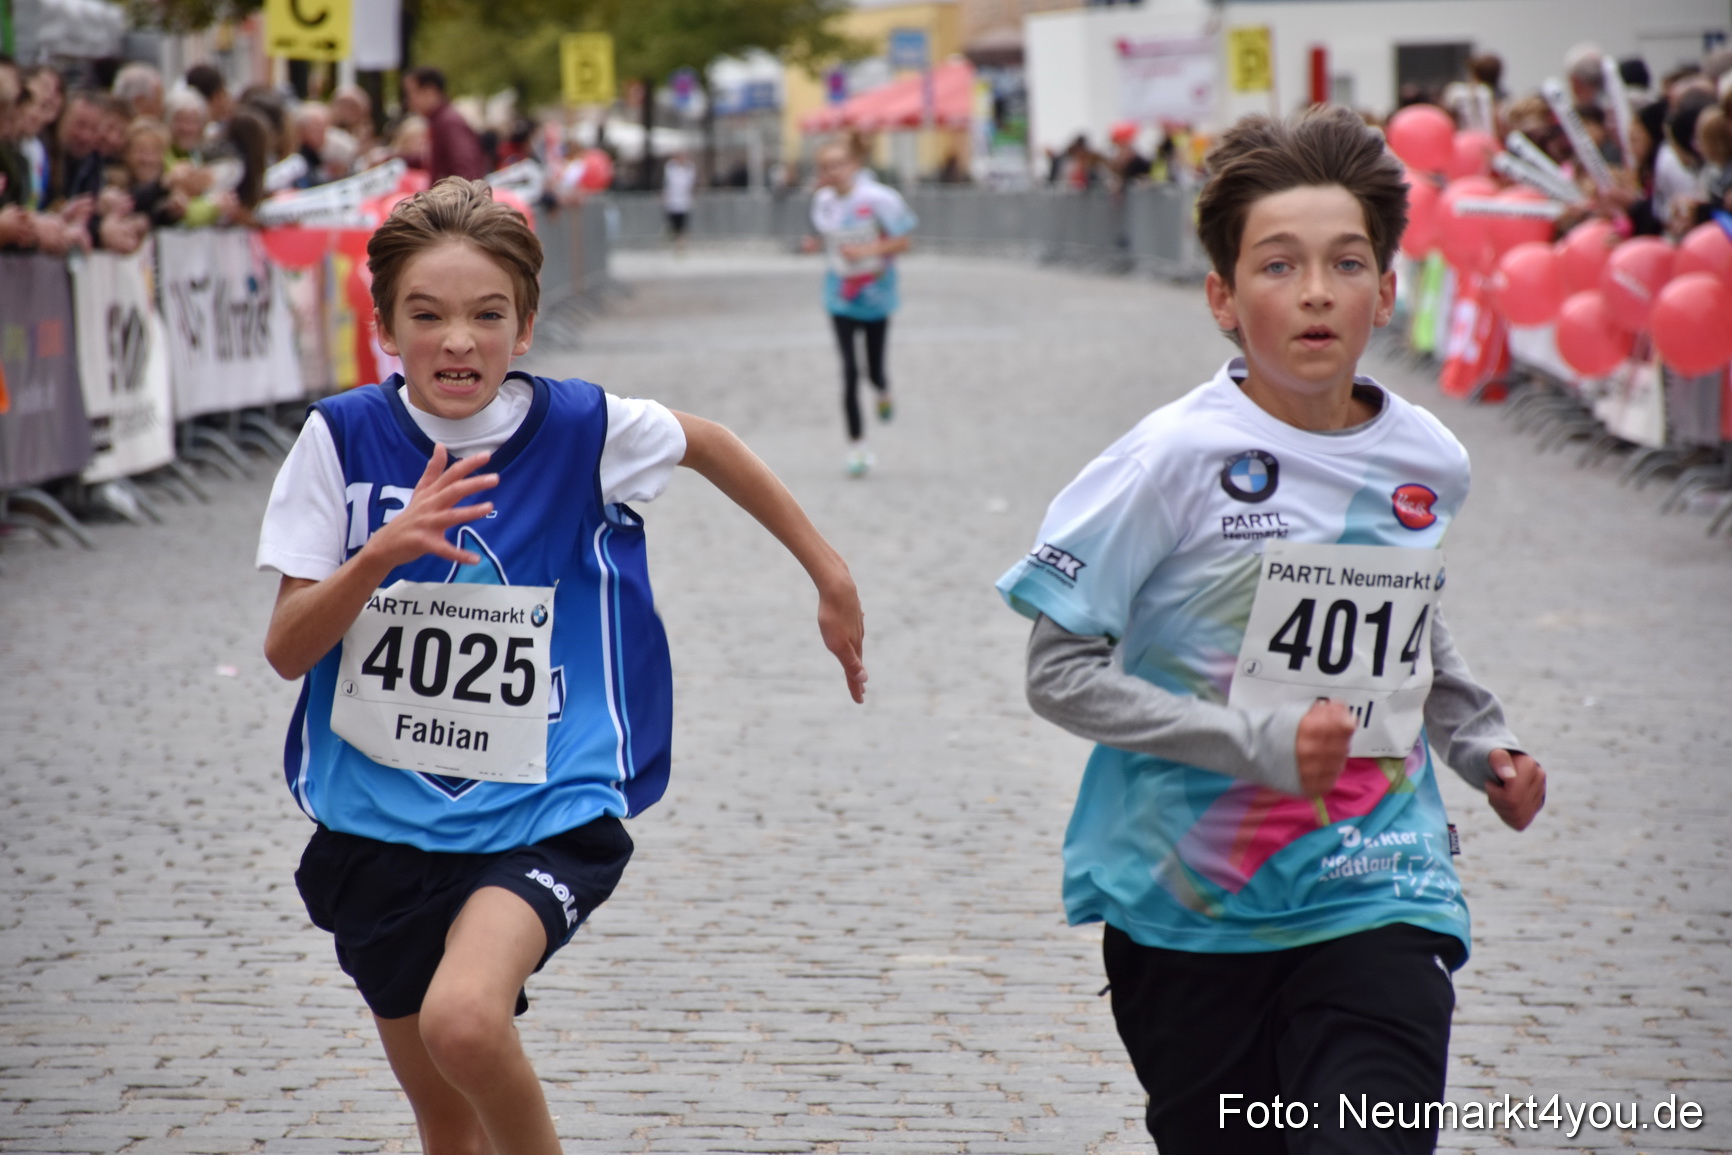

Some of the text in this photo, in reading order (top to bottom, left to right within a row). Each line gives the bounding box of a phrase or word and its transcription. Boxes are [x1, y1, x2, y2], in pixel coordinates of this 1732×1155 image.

[1222, 513, 1289, 532] PARTL
[1268, 563, 1431, 590] PARTL Neumarkt
[366, 597, 424, 616] ARTL
[429, 600, 525, 625] Neumarkt
[1268, 598, 1430, 677] 4014
[361, 626, 536, 707] 4025
[395, 714, 489, 752] Fabian
